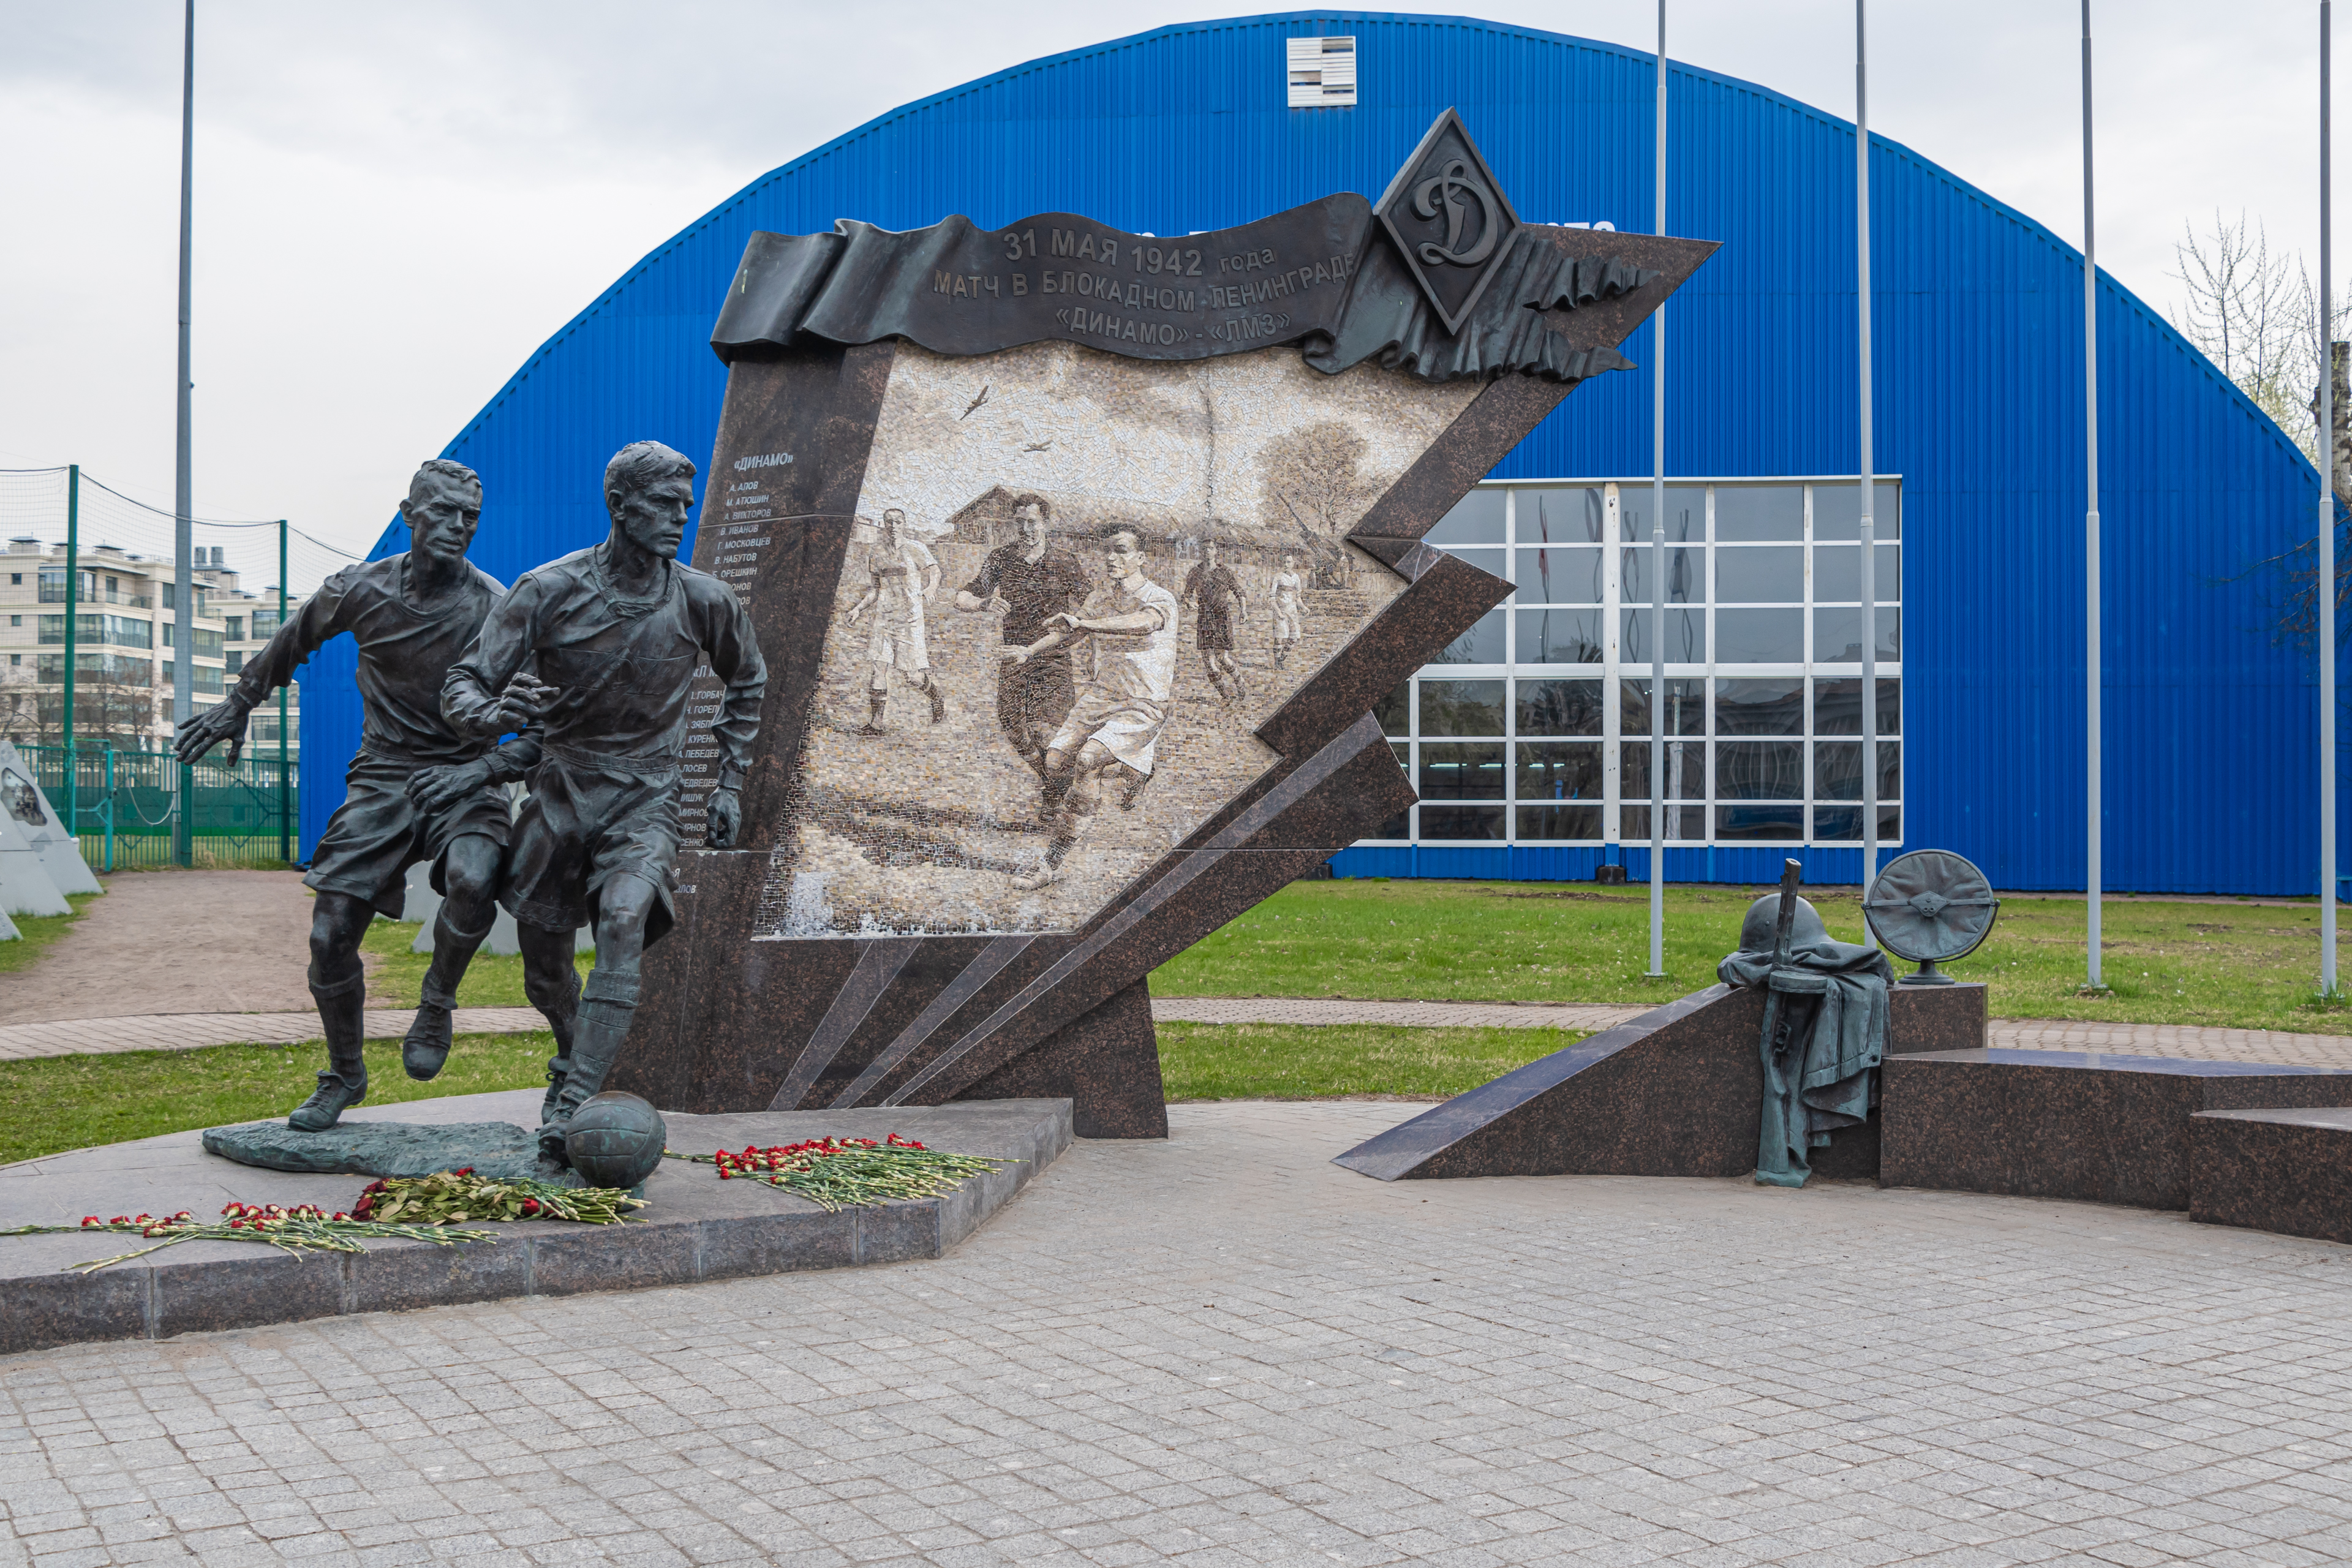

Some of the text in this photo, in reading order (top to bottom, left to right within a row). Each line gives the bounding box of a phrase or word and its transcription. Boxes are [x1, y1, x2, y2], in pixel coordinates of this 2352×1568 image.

[1004, 228, 1275, 276] 31 МАЯ 1942 года
[934, 253, 1354, 312] МАТЧ В БЛОКАДНОМ ЛЕНИНГРАДЕ
[736, 494, 769, 506] АТЮШИН
[733, 508, 772, 520] ВИКТОРОВ
[729, 524, 760, 535] ИВАНОВ
[725, 537, 771, 549] МОСКОВЦЕВ
[723, 552, 758, 564] НАБУТОВ
[720, 567, 758, 578] ОРЕШКИН
[729, 582, 752, 591] ОНОВ
[685, 748, 720, 758] ЛЕБЕДЕВ
[682, 764, 707, 772] ЛОСЕВ
[684, 778, 718, 788] ЕДВЕДЕВ
[678, 808, 709, 817] МИРНОВ
